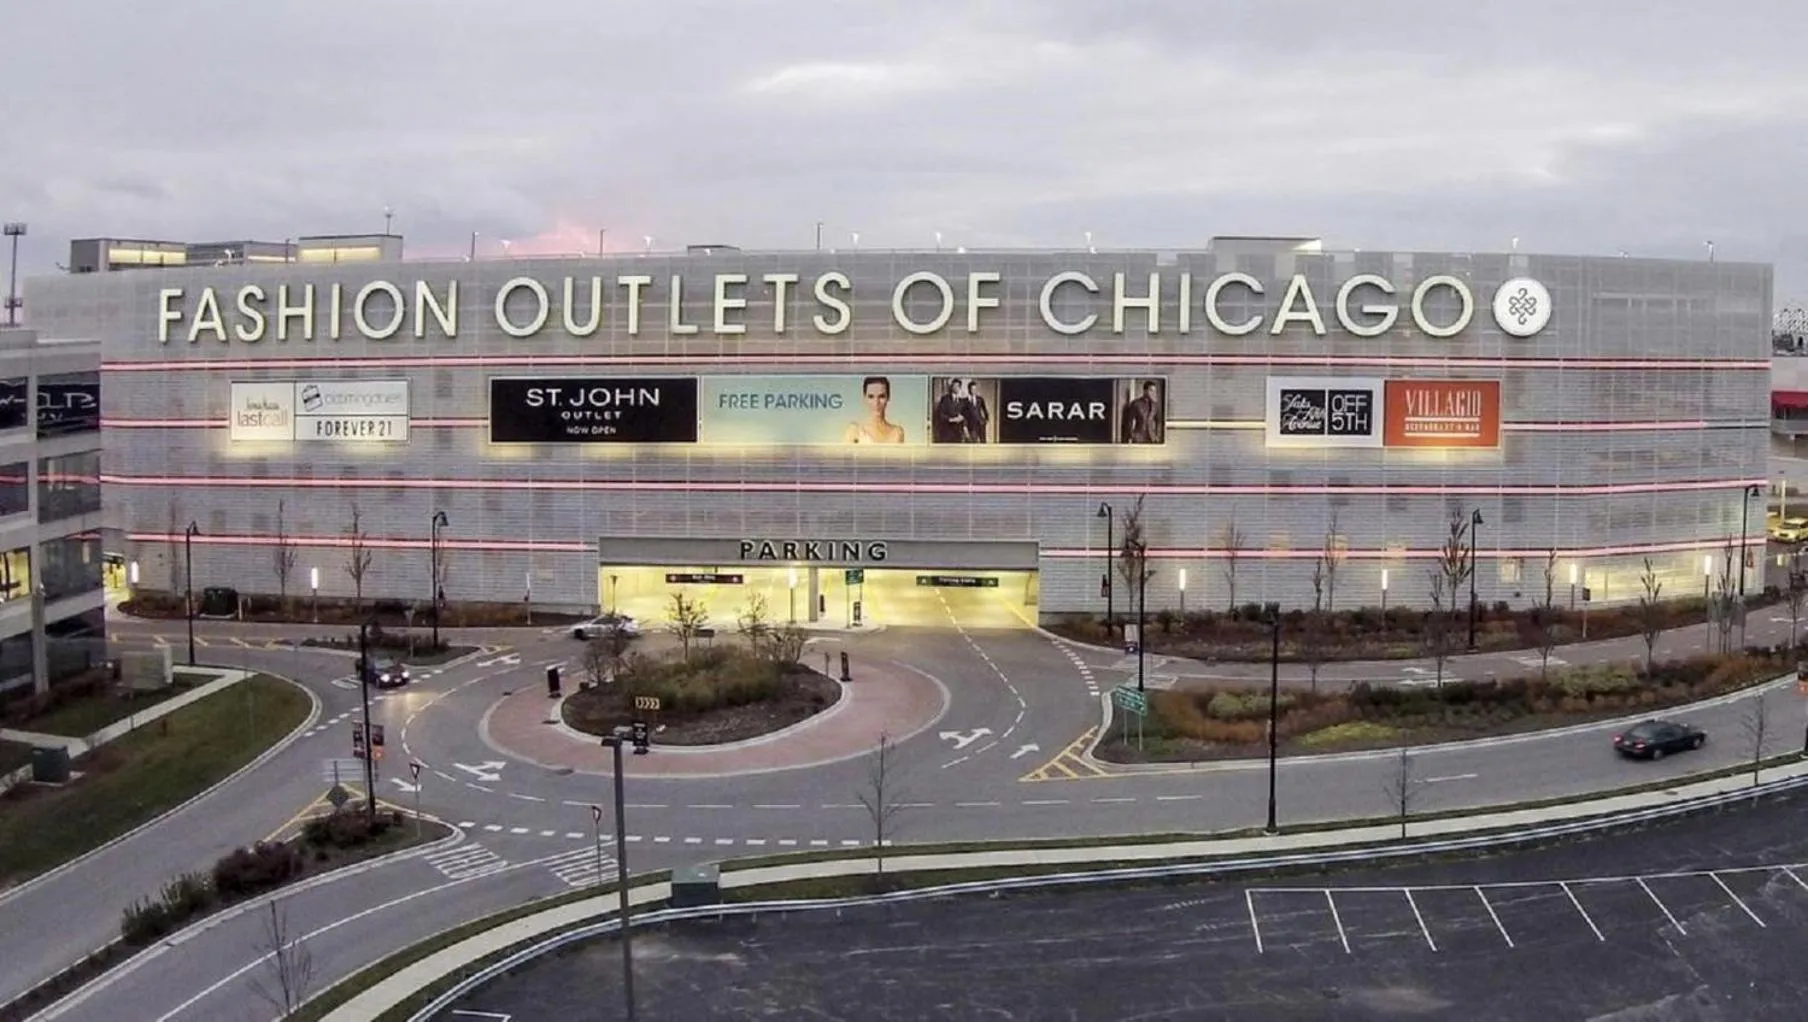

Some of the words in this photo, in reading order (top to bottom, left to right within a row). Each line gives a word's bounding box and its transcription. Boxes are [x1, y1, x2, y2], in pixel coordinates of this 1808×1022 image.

[158, 279, 458, 343] FASHION
[494, 271, 852, 337] OUTLETS
[892, 271, 1001, 335] OF
[1039, 271, 1474, 337] CHICAGO
[569, 387, 660, 407] JOHN
[718, 393, 760, 409] FREE
[763, 393, 844, 409] PARKING
[1331, 394, 1368, 412] OFF
[560, 411, 622, 420] OUTLET
[1006, 402, 1105, 420] SARAR
[316, 420, 375, 437] FOREVER
[378, 420, 392, 436] 21
[566, 425, 589, 434] NOW
[591, 425, 617, 434] OPEN
[1331, 412, 1368, 431] 5TH
[740, 539, 888, 561] PARKING
